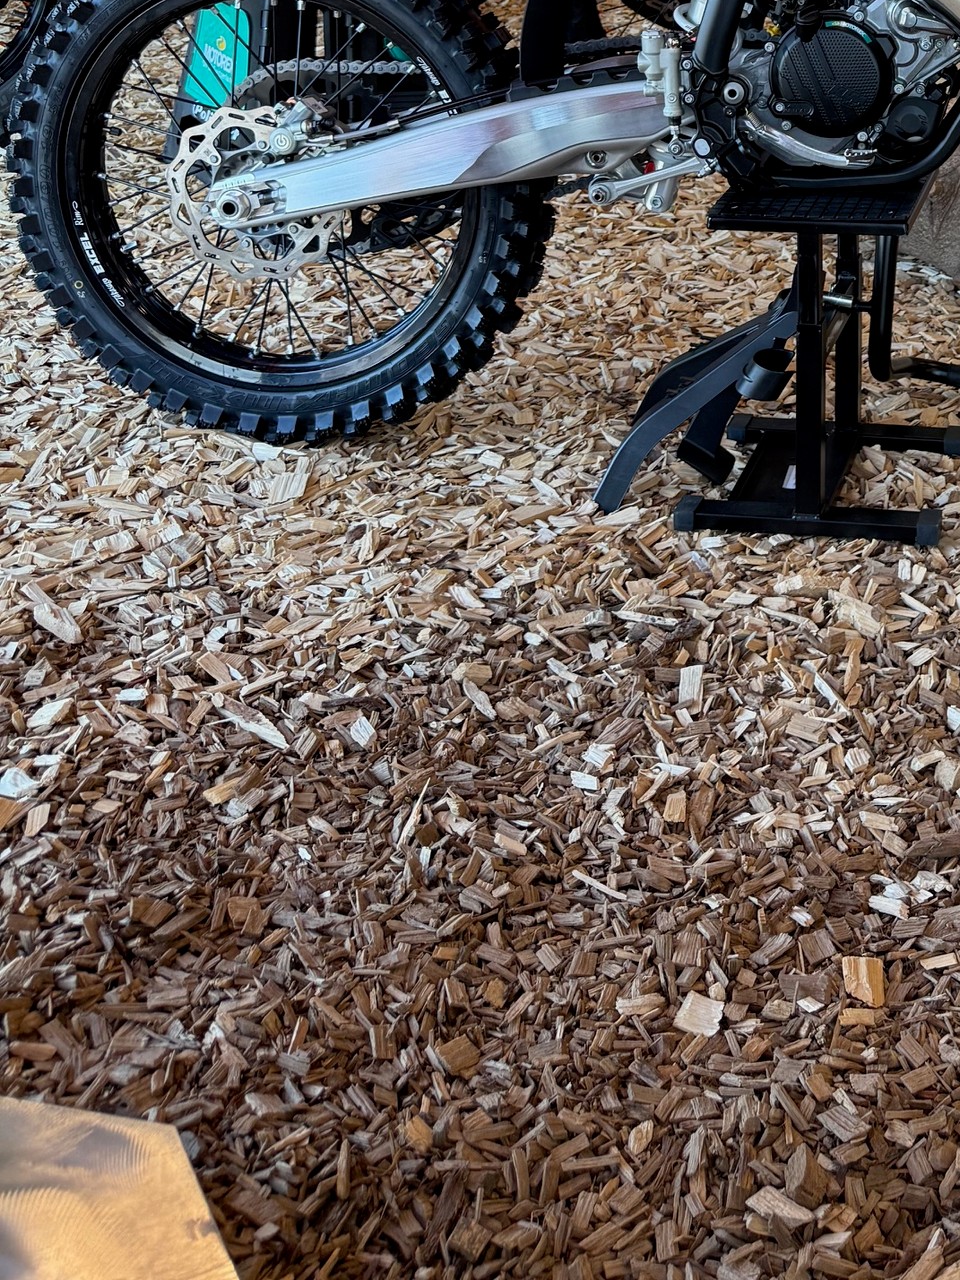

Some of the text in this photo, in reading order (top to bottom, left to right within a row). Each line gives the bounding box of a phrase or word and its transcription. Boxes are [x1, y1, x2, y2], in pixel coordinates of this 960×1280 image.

[204, 43, 234, 74] MOTORE
[72, 200, 84, 226] Rim
[80, 231, 106, 276] EXCEL
